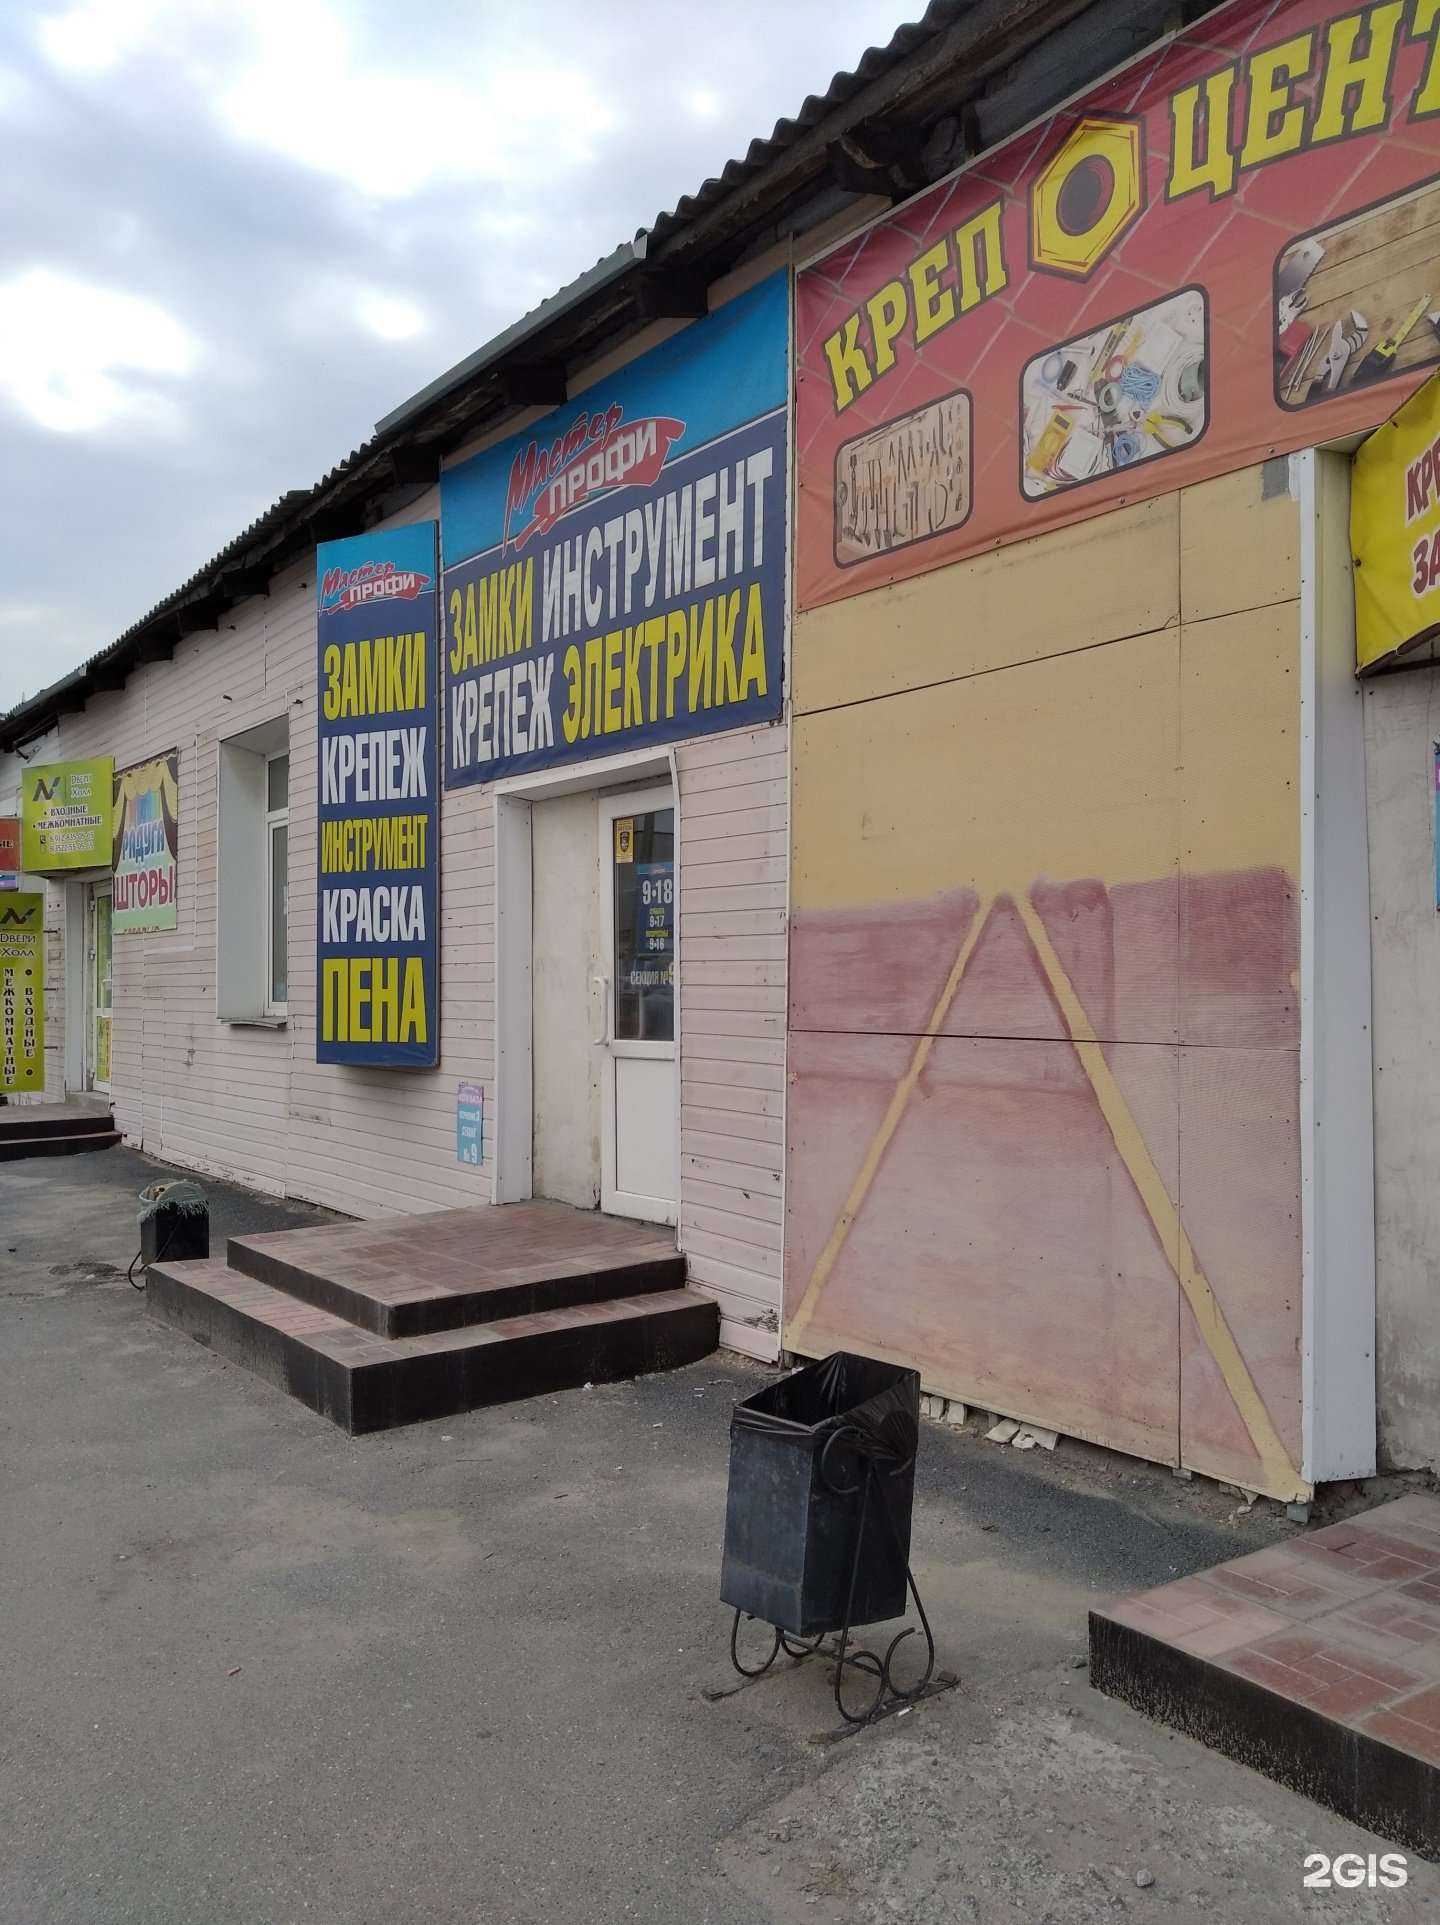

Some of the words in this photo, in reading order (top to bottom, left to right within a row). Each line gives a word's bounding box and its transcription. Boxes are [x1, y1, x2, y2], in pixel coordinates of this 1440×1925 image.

[822, 201, 1009, 415] КРЕП
[546, 421, 657, 514] ПРОФИ
[349, 574, 415, 602] ПРОФИ
[449, 557, 534, 675] ЗАМКИ
[542, 447, 774, 643] ИНСТРУМЕНТ
[322, 632, 427, 720] ЗАМКИ
[452, 653, 555, 769] КРЕПЕЖ
[562, 583, 768, 744] ЭЛЕКТРИКА
[322, 727, 428, 804] КРЕПЕЖ
[36, 816, 102, 829] МЕЖКОМНАТНЫЕ
[50, 805, 87, 816] ВХОДНЫЕ
[321, 815, 428, 874] ИНСТРУМЕНТ
[115, 866, 173, 910] ШТОРЫ
[322, 886, 426, 943] КРАСКА
[3, 968, 15, 1085] МЕЖКОМНАТНЫЕ
[24, 987, 35, 1057] ВХОДНЫЕ
[322, 957, 427, 1043] ПЕНА
